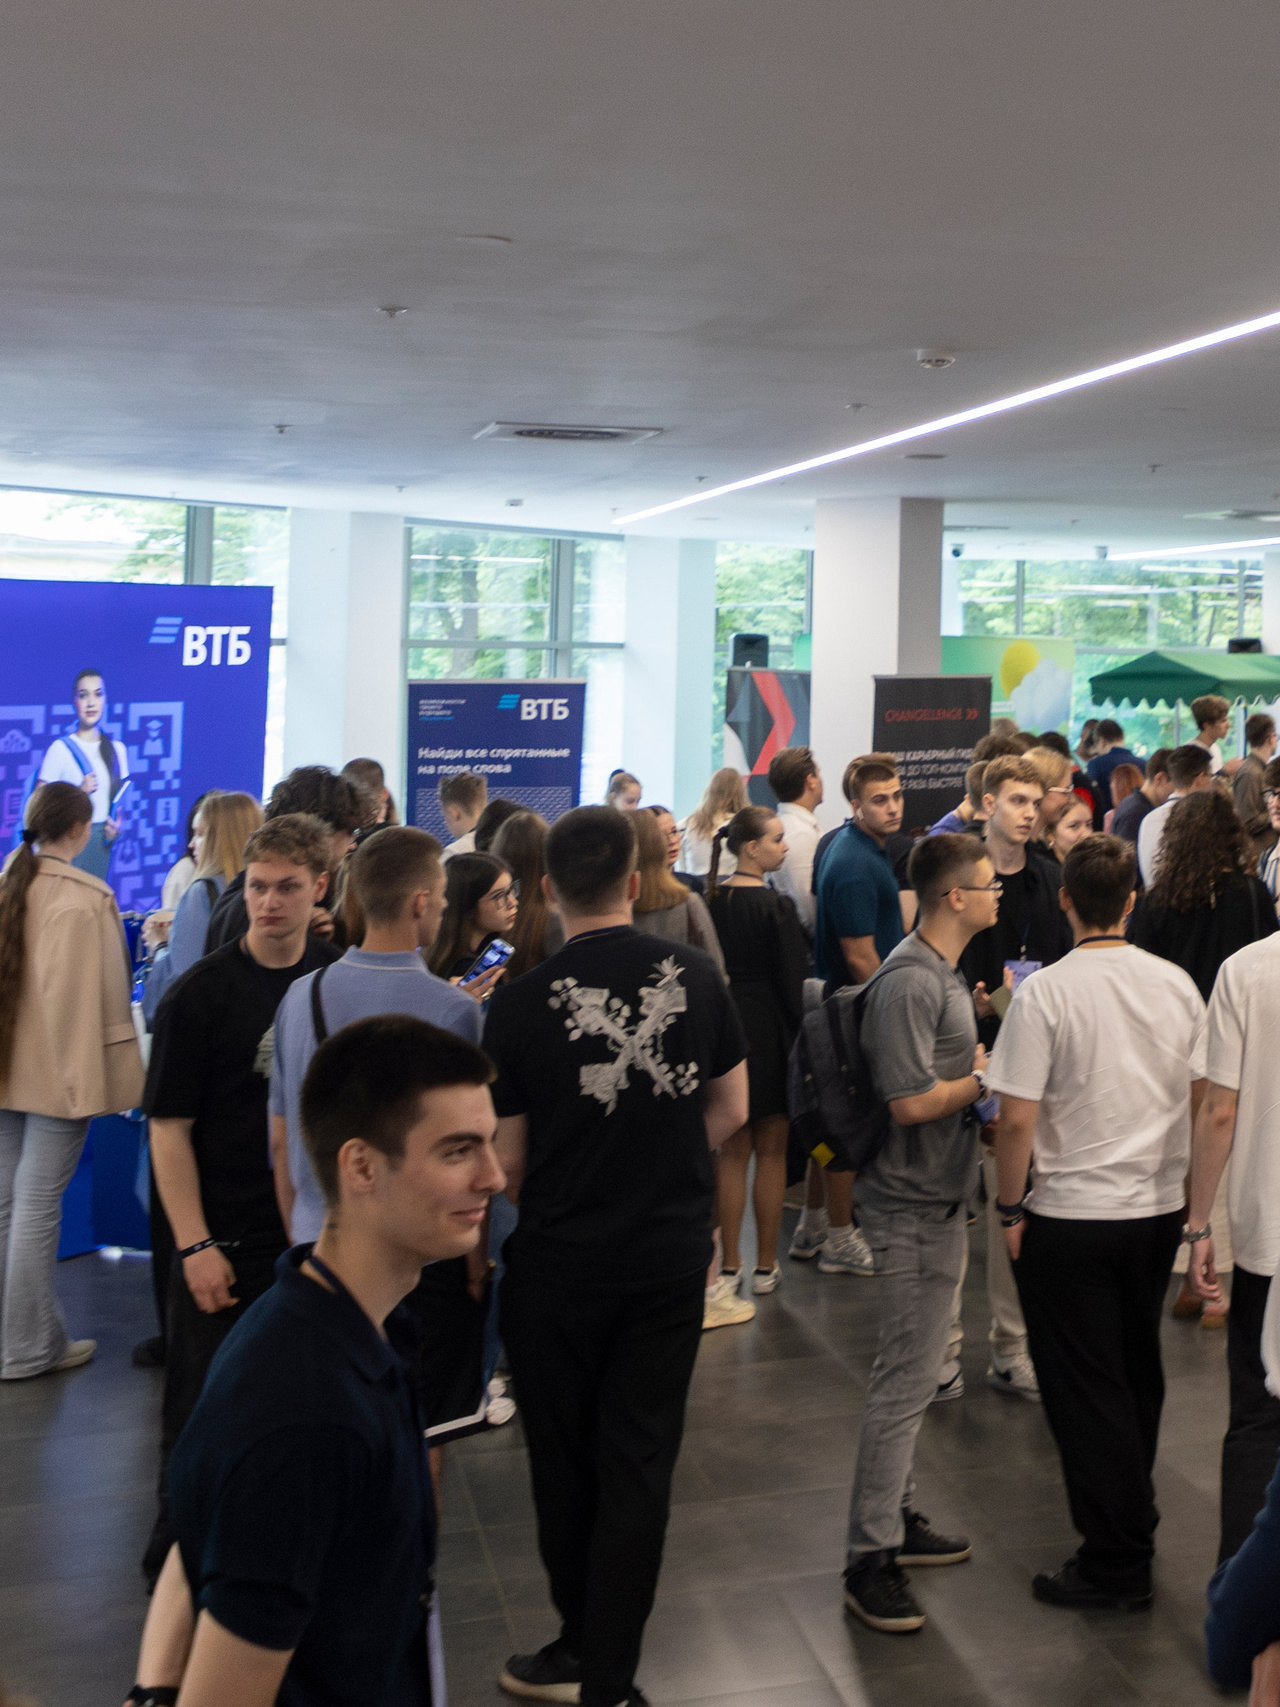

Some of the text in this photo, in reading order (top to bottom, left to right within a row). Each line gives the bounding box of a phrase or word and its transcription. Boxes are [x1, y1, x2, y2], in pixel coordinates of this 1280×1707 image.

[182, 625, 252, 666] ВТБ
[520, 698, 570, 721] ВТБ
[417, 747, 571, 760] Найди все спрятанные
[417, 764, 512, 775] на поле слова
